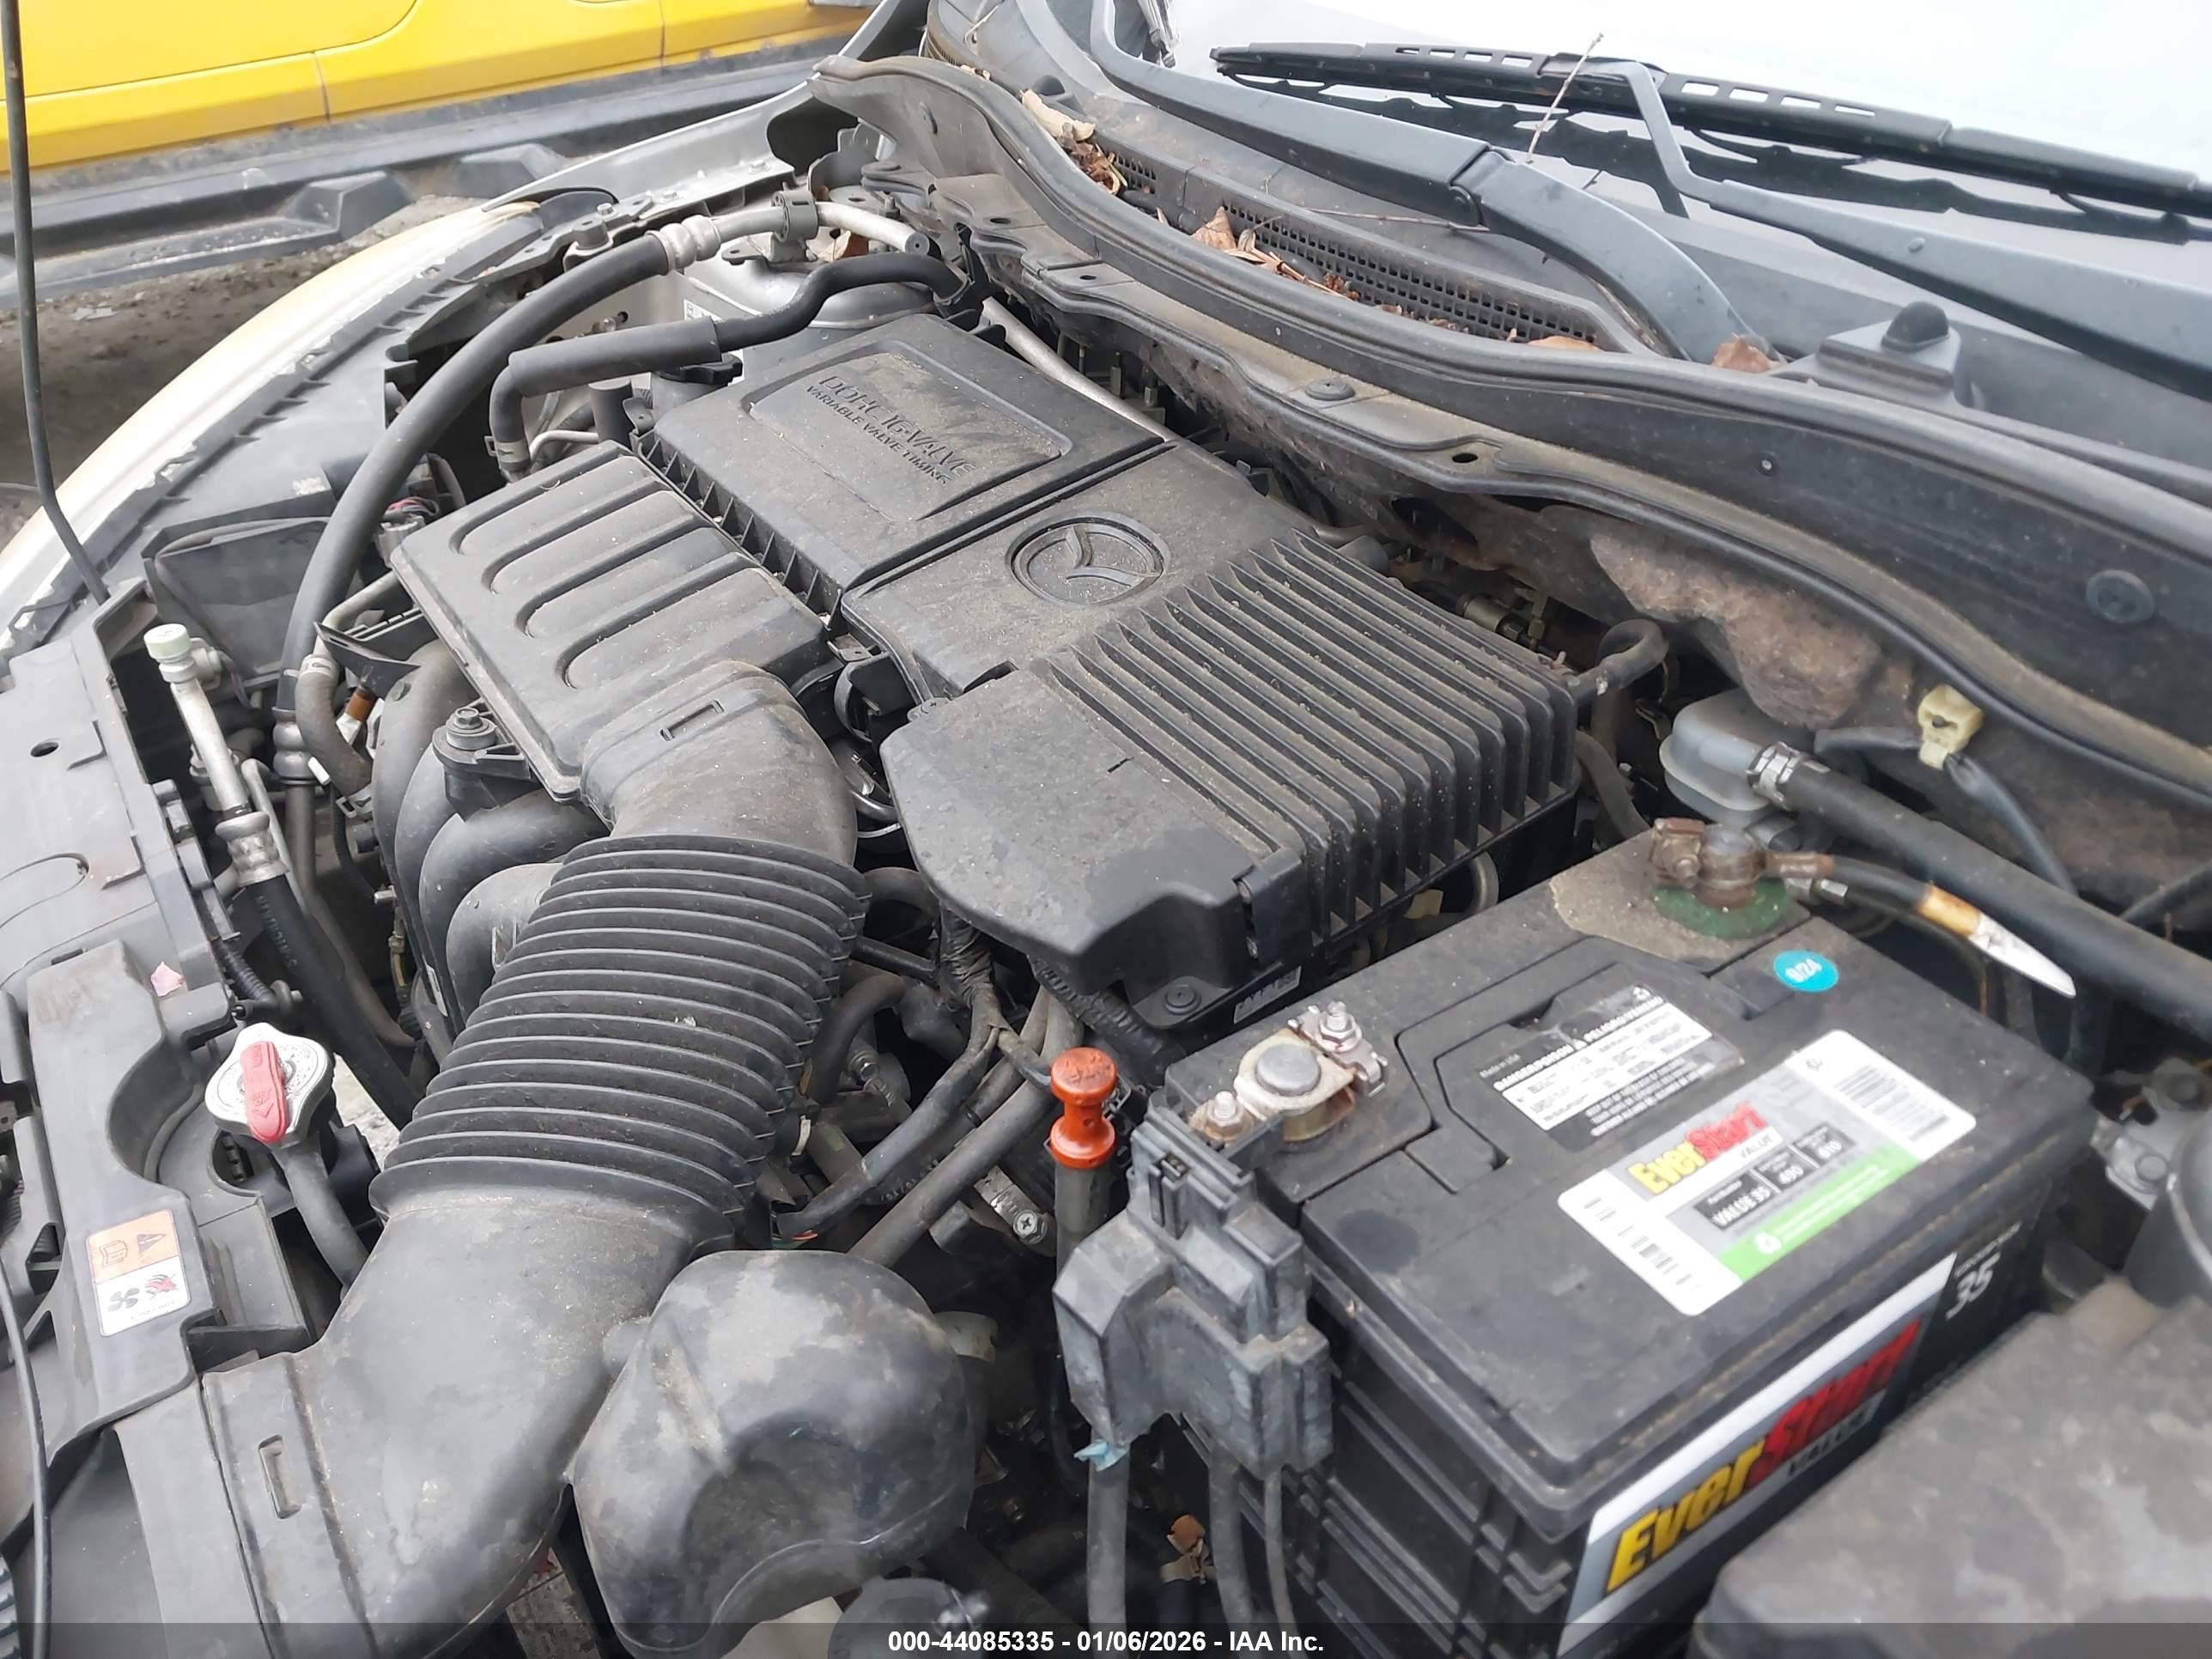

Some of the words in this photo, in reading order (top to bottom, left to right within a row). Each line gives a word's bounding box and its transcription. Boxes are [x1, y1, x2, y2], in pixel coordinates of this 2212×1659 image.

[819, 375, 892, 420] DOHC
[806, 386, 865, 425] VARIABLE
[863, 422, 904, 453] VALVE
[902, 448, 951, 484] TIMING
[1712, 1194, 1757, 1227] VALUE
